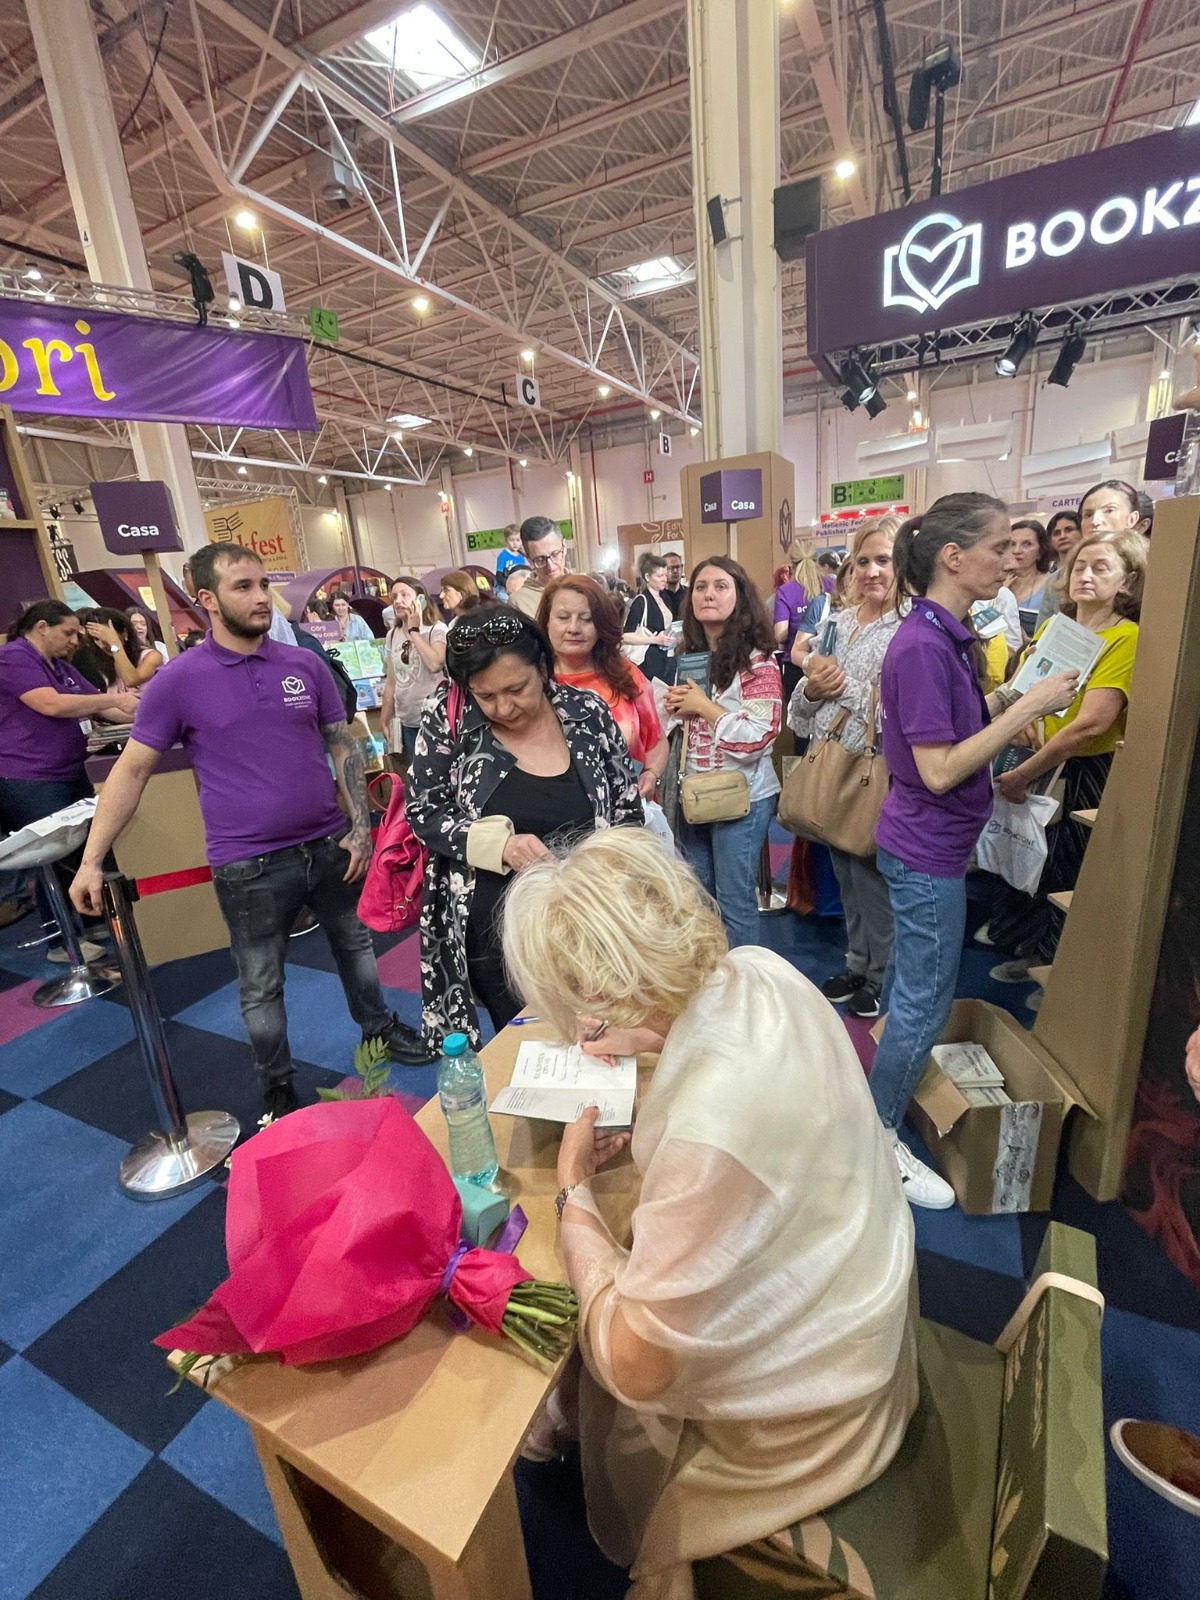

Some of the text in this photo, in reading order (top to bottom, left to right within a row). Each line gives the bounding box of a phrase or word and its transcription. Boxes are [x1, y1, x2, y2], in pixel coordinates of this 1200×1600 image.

[237, 262, 273, 309] D
[522, 378, 536, 405] C
[663, 436, 670, 454] B
[704, 502, 717, 512] Casa
[731, 500, 755, 510] Casa
[117, 524, 160, 537] Casa
